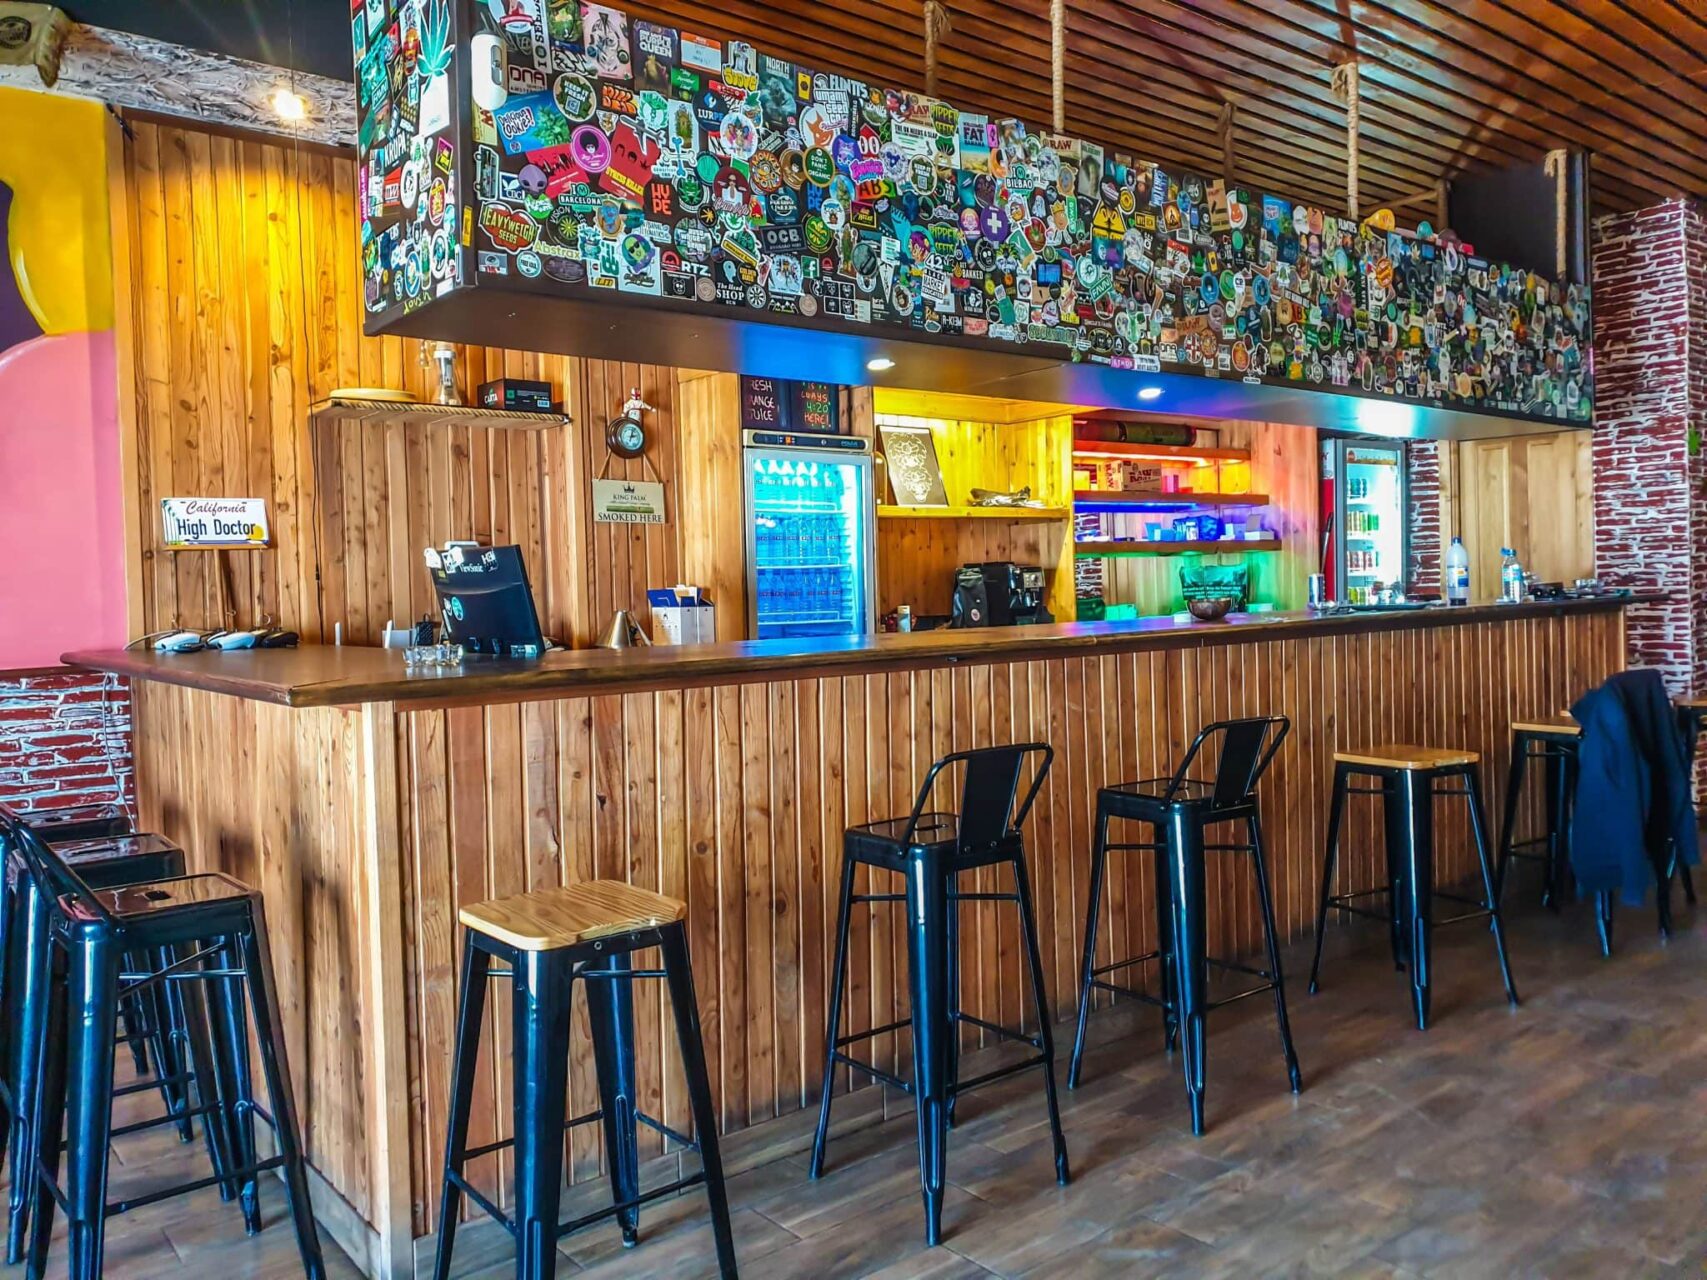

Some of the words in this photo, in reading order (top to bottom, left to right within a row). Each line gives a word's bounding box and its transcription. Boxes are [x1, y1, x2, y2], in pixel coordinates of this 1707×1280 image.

[640, 42, 673, 58] QUEEN
[766, 57, 790, 74] NORTH
[510, 67, 546, 87] DNA
[564, 80, 582, 92] KEEP
[581, 90, 589, 98] IT
[564, 88, 586, 102] FRESH
[964, 126, 985, 141] FAT
[1050, 140, 1072, 150] RAW
[1006, 180, 1033, 189] BILBAO
[560, 195, 602, 205] BARCELONA
[549, 206, 571, 224] VISION
[482, 206, 536, 242] HEAVYWEIGH
[499, 229, 518, 244] SEEDS
[767, 228, 800, 243] OCB
[533, 240, 581, 259] Abstrax
[716, 289, 745, 301] SHOP
[806, 401, 829, 413] 4:20
[186, 500, 247, 517] California
[598, 512, 637, 522] SMOKED
[639, 514, 663, 523] HERE
[177, 519, 207, 540] High
[213, 519, 256, 535] Doctor
